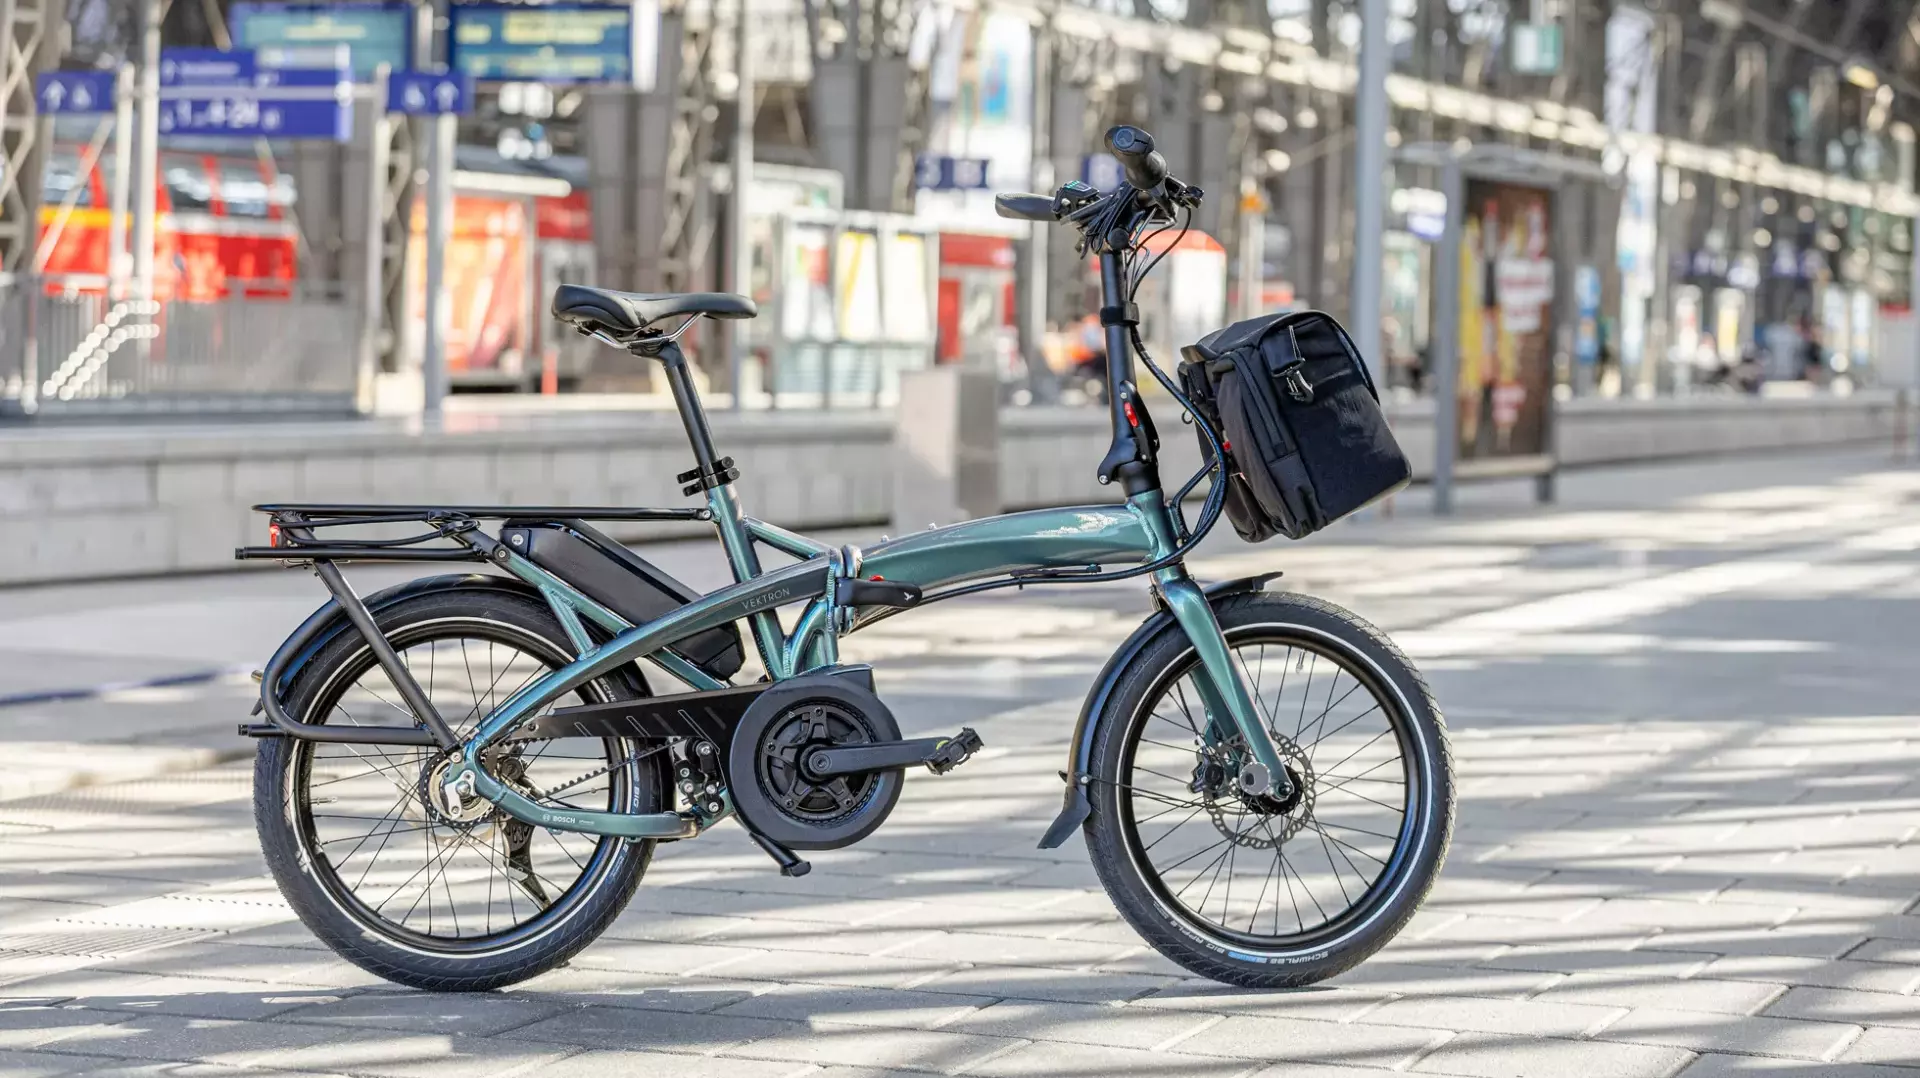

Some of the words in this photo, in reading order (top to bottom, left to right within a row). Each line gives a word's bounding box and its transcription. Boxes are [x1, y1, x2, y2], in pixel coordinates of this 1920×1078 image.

[741, 588, 790, 609] VEKTRON
[552, 815, 576, 824] BOSCH
[1170, 920, 1204, 944] APPLE
[1206, 943, 1226, 954] BIG
[1270, 951, 1329, 965] SCHWALBE
